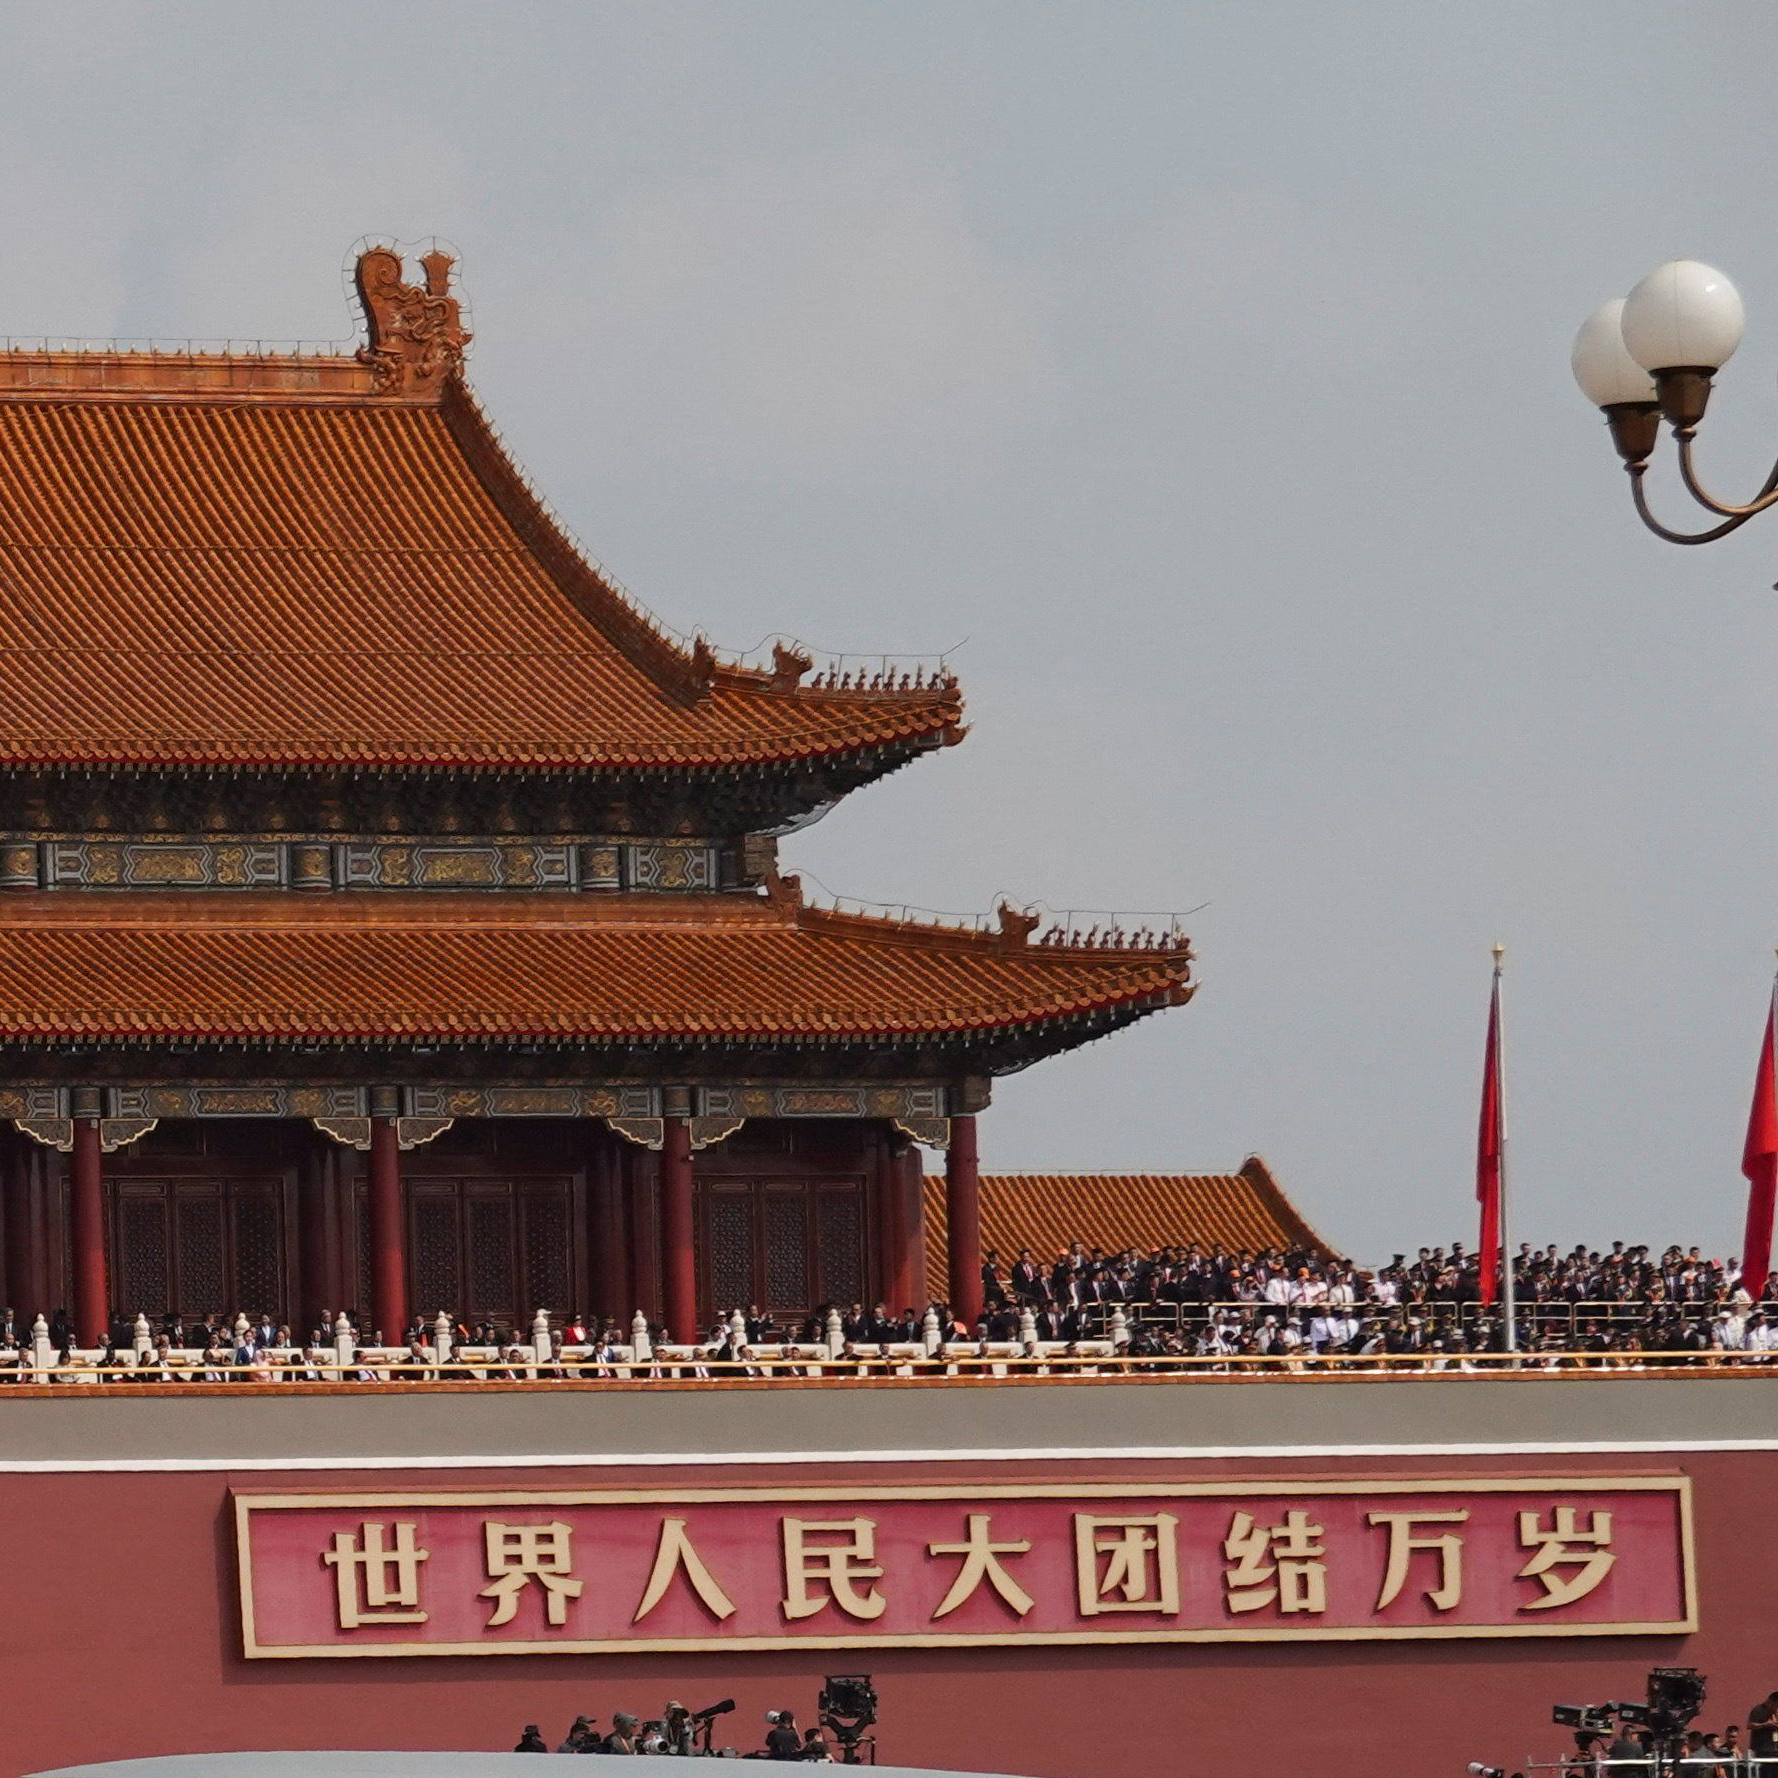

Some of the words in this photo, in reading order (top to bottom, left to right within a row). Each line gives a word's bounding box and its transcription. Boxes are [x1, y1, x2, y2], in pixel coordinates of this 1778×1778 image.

[321, 1505, 1617, 1630] 世界人民大团结万岁
